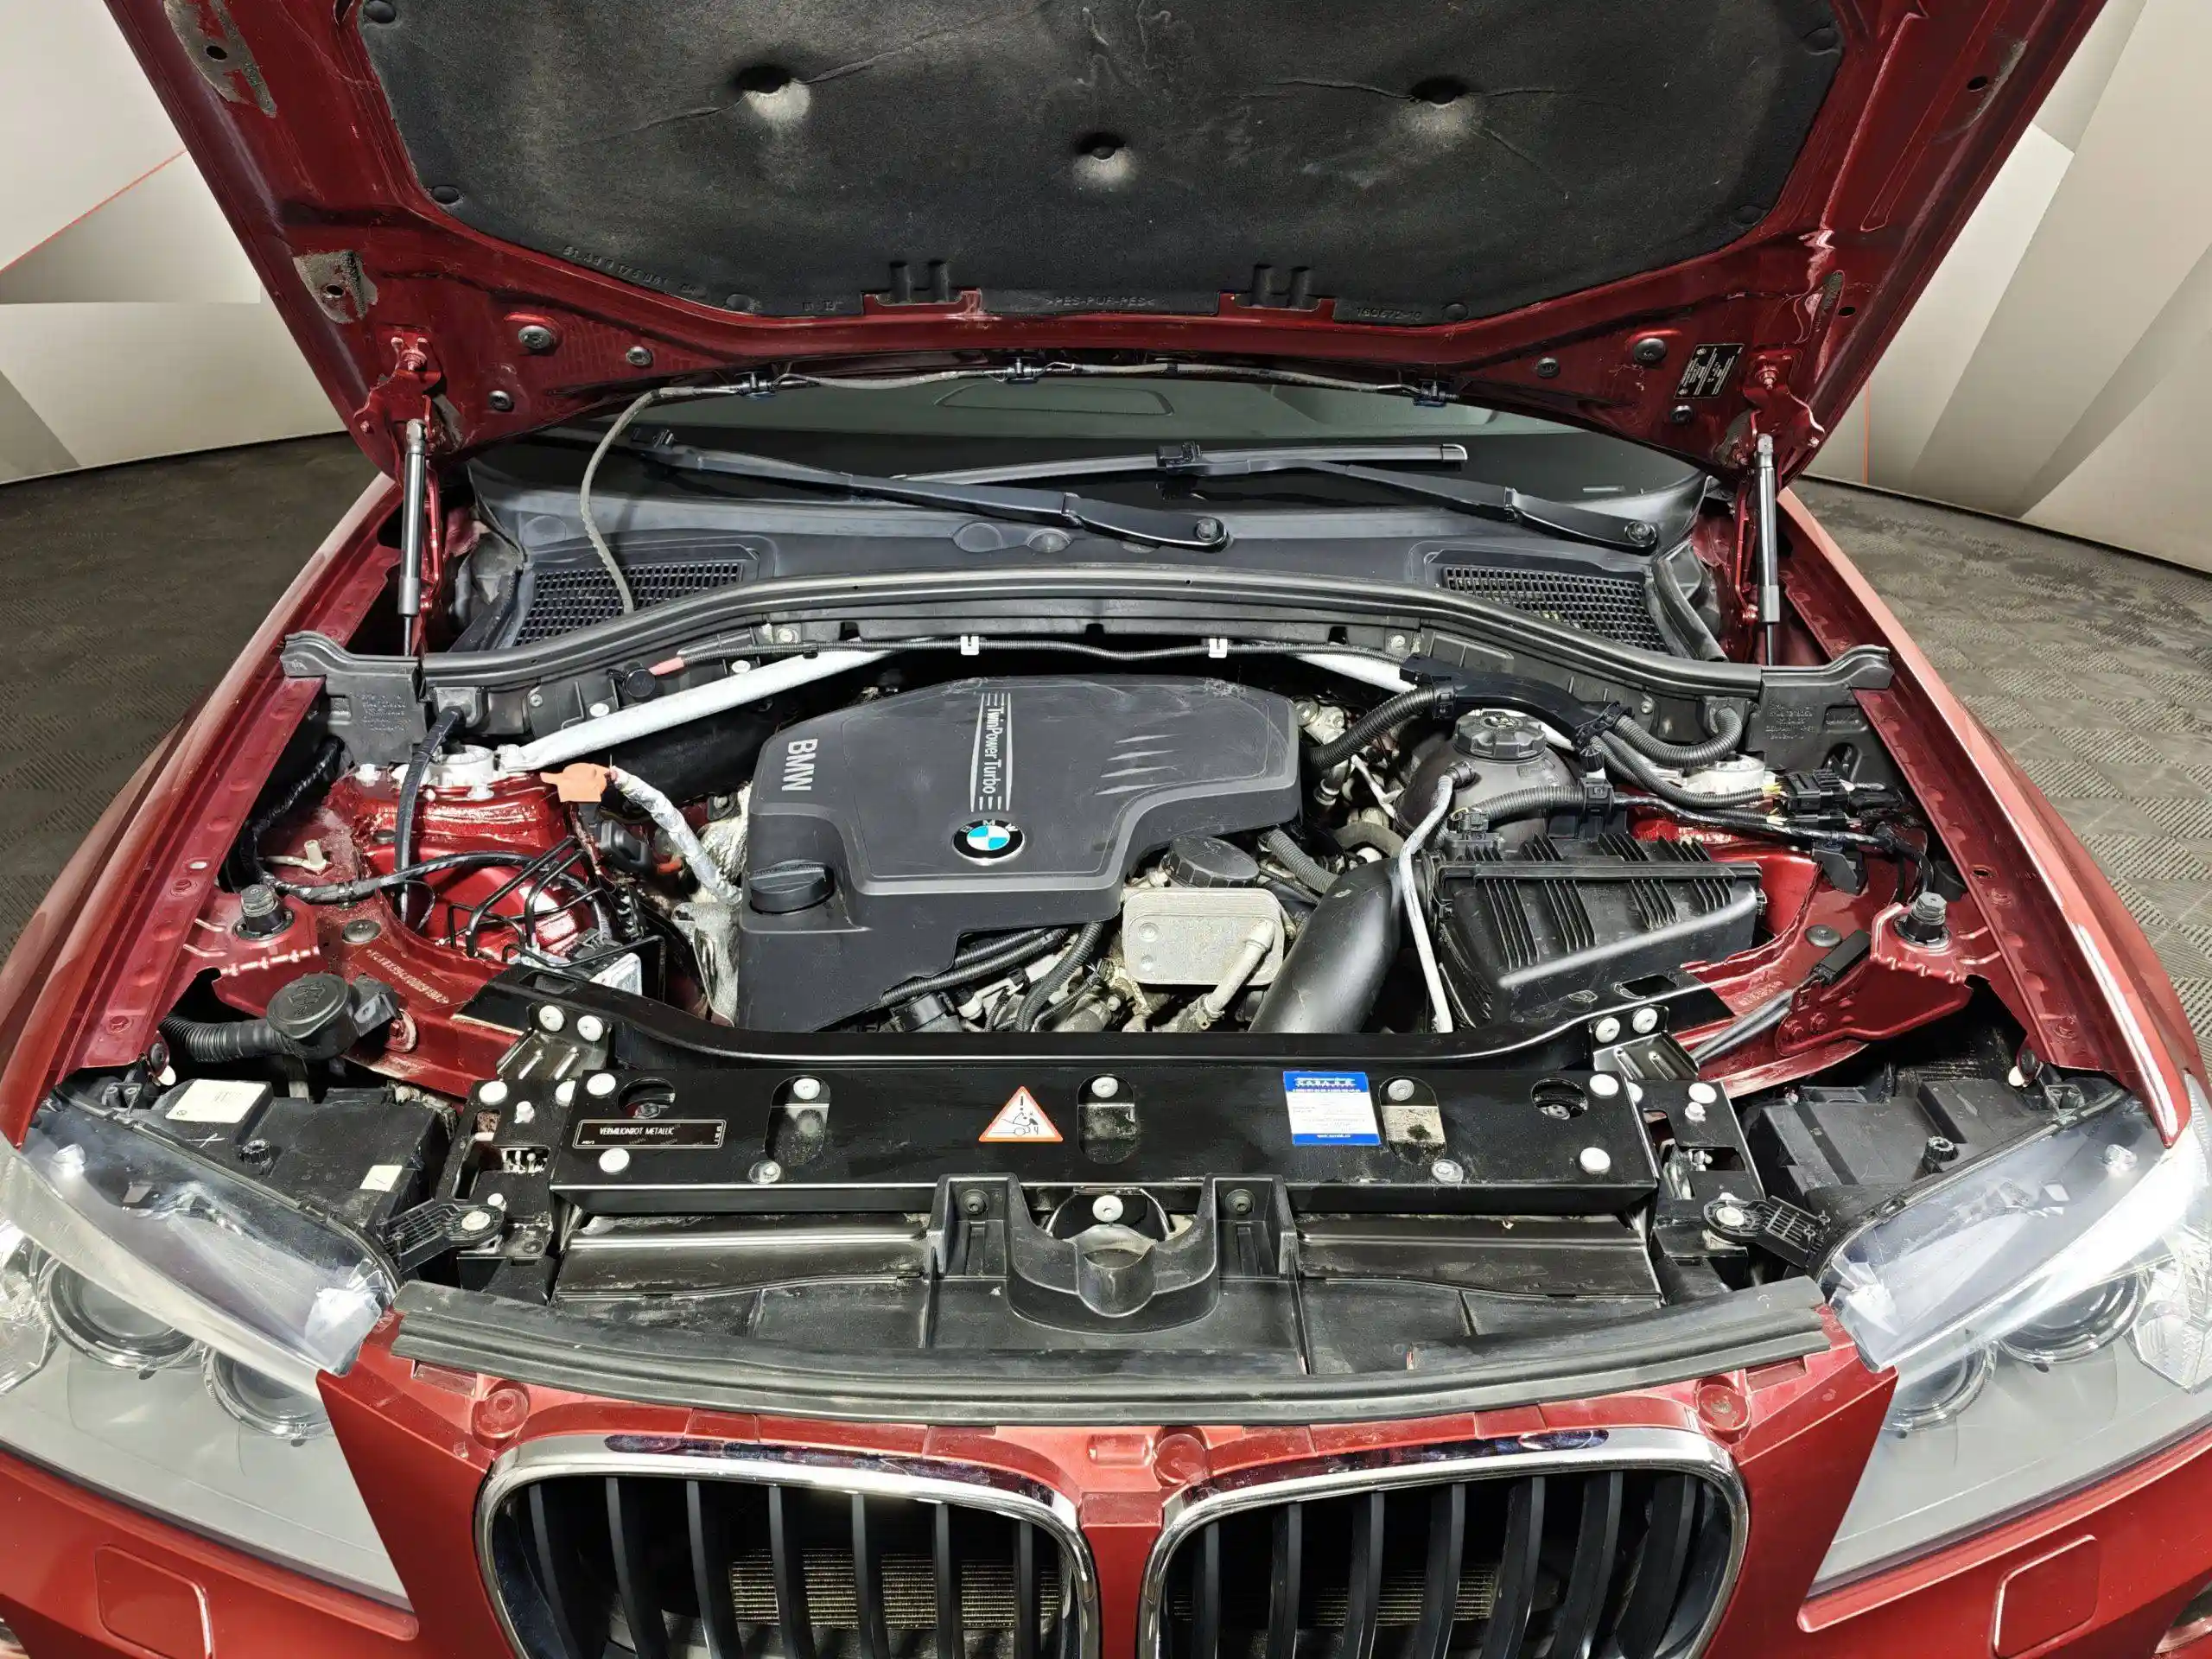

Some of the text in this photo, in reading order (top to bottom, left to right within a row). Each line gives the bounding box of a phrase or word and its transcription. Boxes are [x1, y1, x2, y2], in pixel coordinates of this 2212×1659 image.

[781, 738, 818, 791] BMW
[982, 706, 1004, 794] TwinPower Turbo
